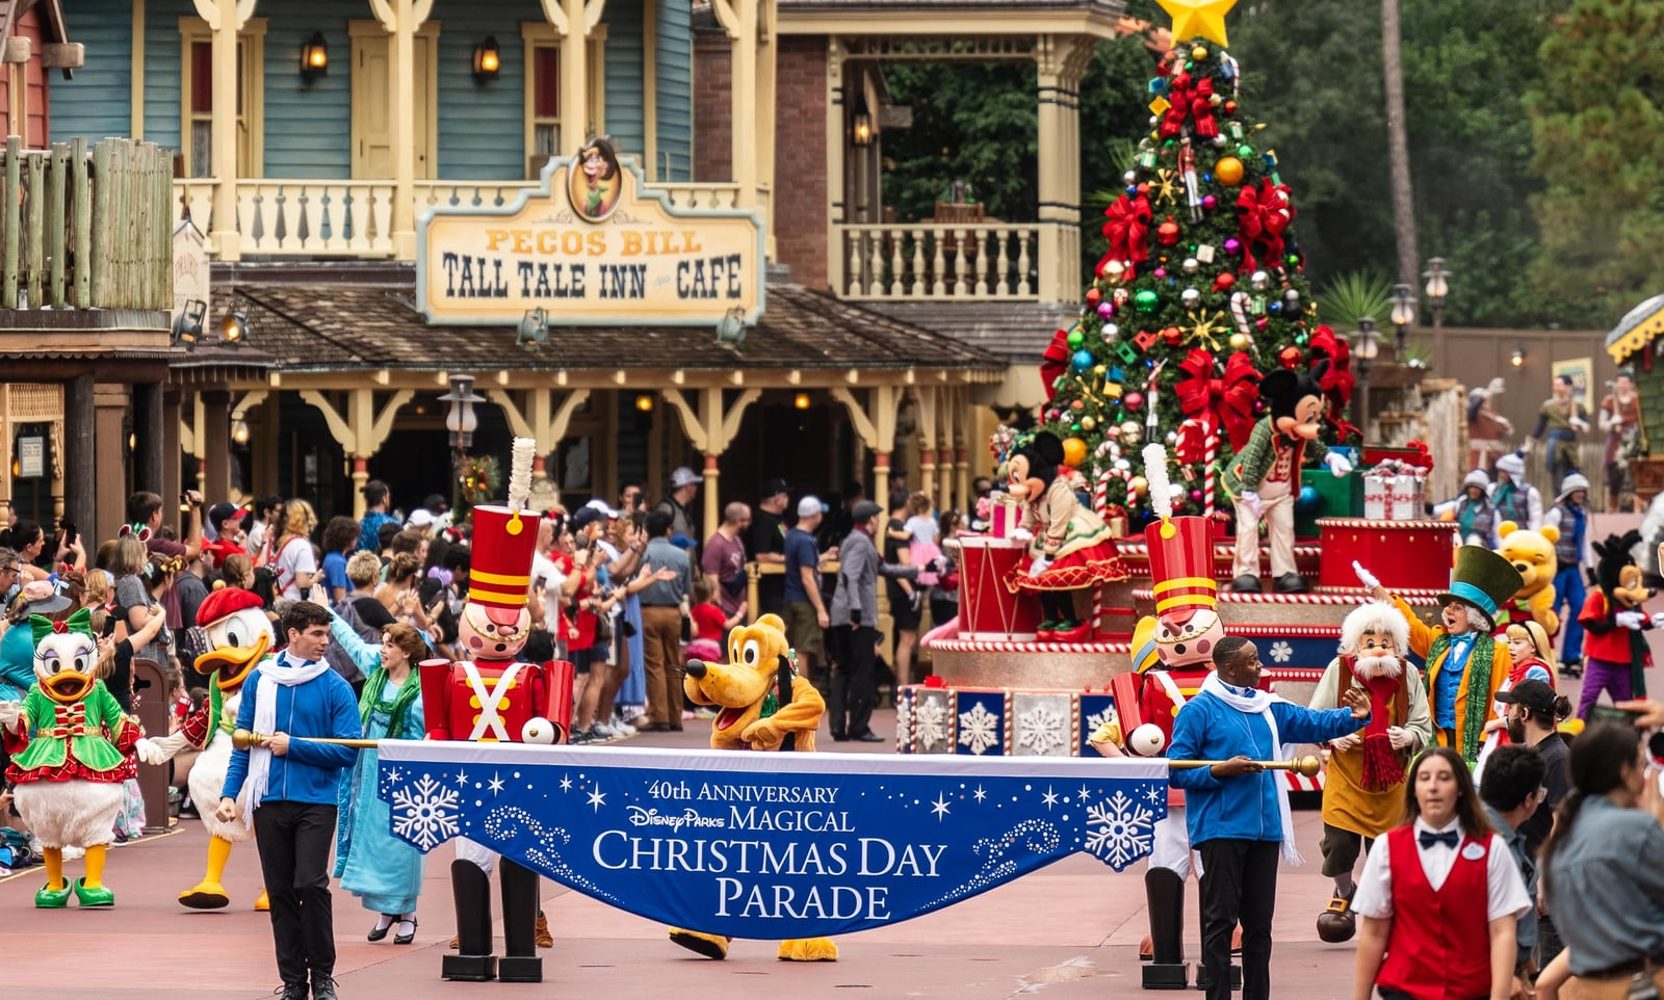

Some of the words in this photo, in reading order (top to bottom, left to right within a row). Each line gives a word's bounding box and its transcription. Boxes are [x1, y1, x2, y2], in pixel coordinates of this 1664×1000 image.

[486, 229, 607, 256] PECOS
[620, 229, 702, 256] BILL
[443, 252, 508, 298] TALL
[518, 261, 586, 297] TALE
[599, 263, 647, 299] INN
[676, 253, 742, 299] CAFE
[648, 779, 692, 800] 40th
[696, 782, 839, 804] ANNIVERSARY
[728, 805, 856, 832] MAGICAL
[592, 830, 848, 877] CHRISTMAS
[857, 837, 949, 877] DAY
[715, 877, 892, 920] PARADE
